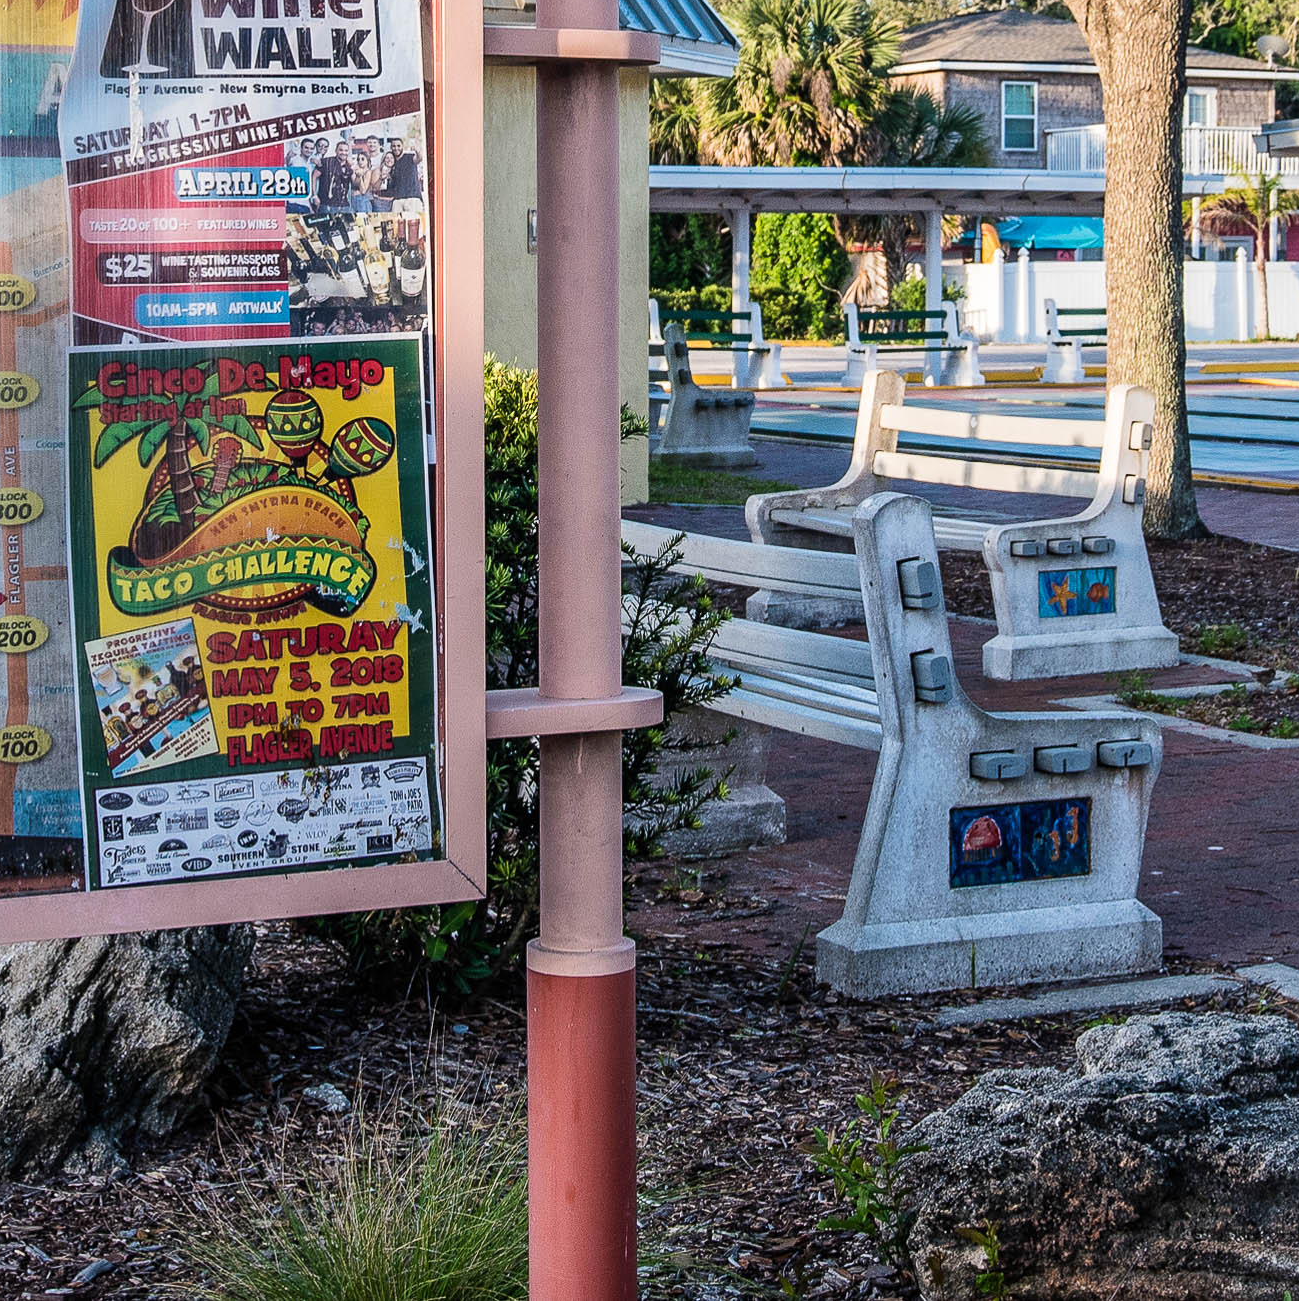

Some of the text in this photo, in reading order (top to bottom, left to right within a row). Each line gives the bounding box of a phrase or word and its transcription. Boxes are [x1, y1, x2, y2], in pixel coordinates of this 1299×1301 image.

[200, 27, 372, 70] WALK
[105, 84, 147, 96] Flagr
[153, 84, 203, 95] Avenue
[220, 84, 247, 94] New
[253, 83, 306, 97] Smyrna
[358, 84, 374, 94] FL
[189, 103, 251, 132] 1-7PM
[113, 106, 357, 172] PROGRESSIVE WINE TASTING
[178, 170, 308, 197] APRIL 28th
[89, 221, 119, 232] TASTE
[119, 218, 138, 231] 20
[197, 219, 247, 230] FEATURED
[249, 219, 278, 230] WINES
[105, 254, 152, 279] $25
[161, 254, 280, 267] WINE TASTING PASSPORT
[201, 267, 248, 278] SOUVENIR
[250, 266, 280, 277] GLASS
[146, 301, 283, 317] 10AM-5PM ARTWALK
[98, 355, 384, 399] Cinco De Mayo
[99, 401, 179, 425] Starting
[183, 401, 204, 419] at
[5, 446, 16, 475] AVE
[210, 496, 348, 536] NEW SMYRNA BEACH
[8, 534, 20, 604] FLAGLER
[116, 551, 370, 603] TACO CHALLENGE
[0, 621, 32, 630] BLOCK
[106, 626, 176, 649] PROGRESSIVE
[91, 646, 138, 662] TEQUILA
[141, 633, 191, 649] TASTING
[212, 654, 403, 698] MAY 5, 2018
[228, 692, 390, 728] 1PM TO 7PM
[2, 730, 35, 740] BLOCK
[226, 720, 394, 767] FLAGLER AVENUE
[1, 741, 38, 758] 100
[217, 843, 320, 863] SOUTHERN STONE
[232, 856, 308, 870] EVENT GROUP
